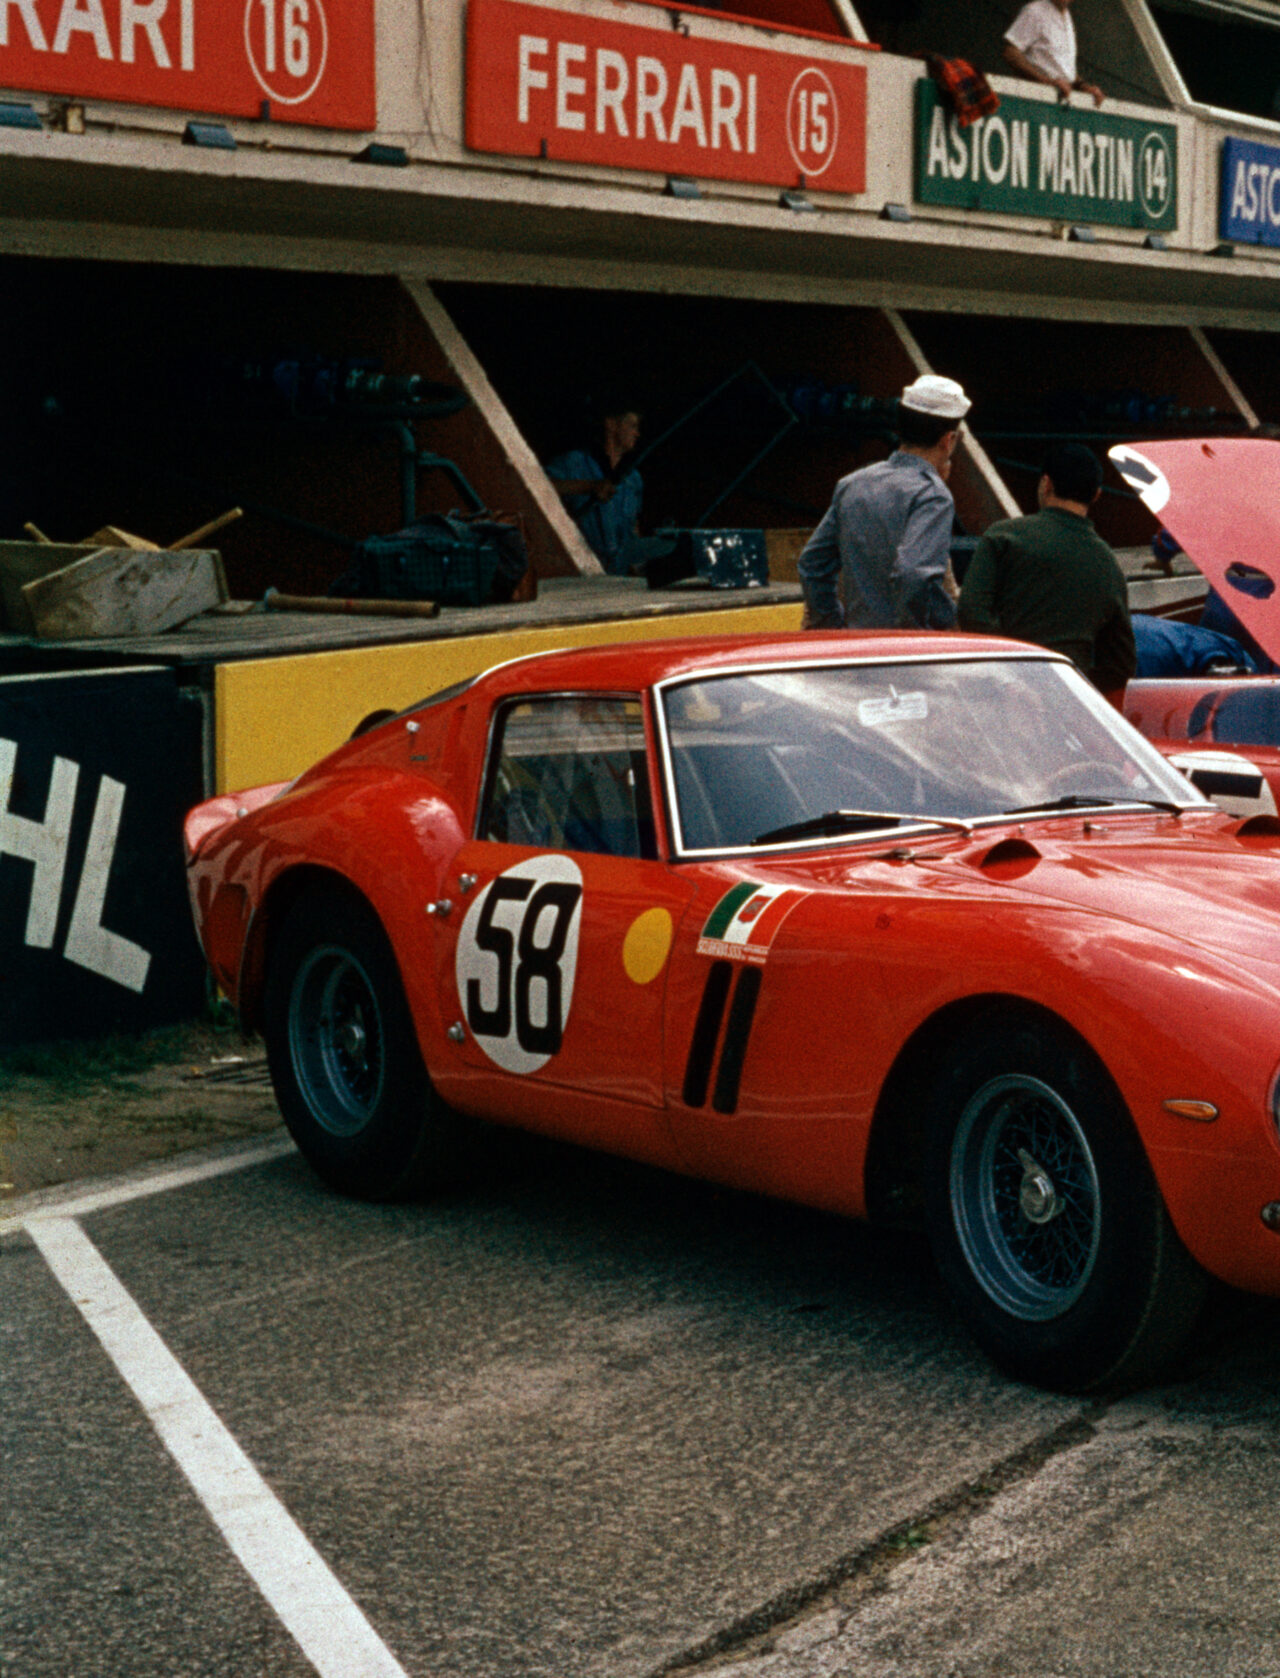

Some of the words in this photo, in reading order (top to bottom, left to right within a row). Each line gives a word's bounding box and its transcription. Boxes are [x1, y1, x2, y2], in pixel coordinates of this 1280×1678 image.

[260, 0, 310, 77] 16
[517, 34, 757, 154] FERRARI
[799, 90, 829, 154] 15
[927, 105, 1029, 189] ASTON
[1039, 124, 1134, 202] MARTIN
[1145, 147, 1167, 202] 14
[467, 876, 583, 1056] 58
